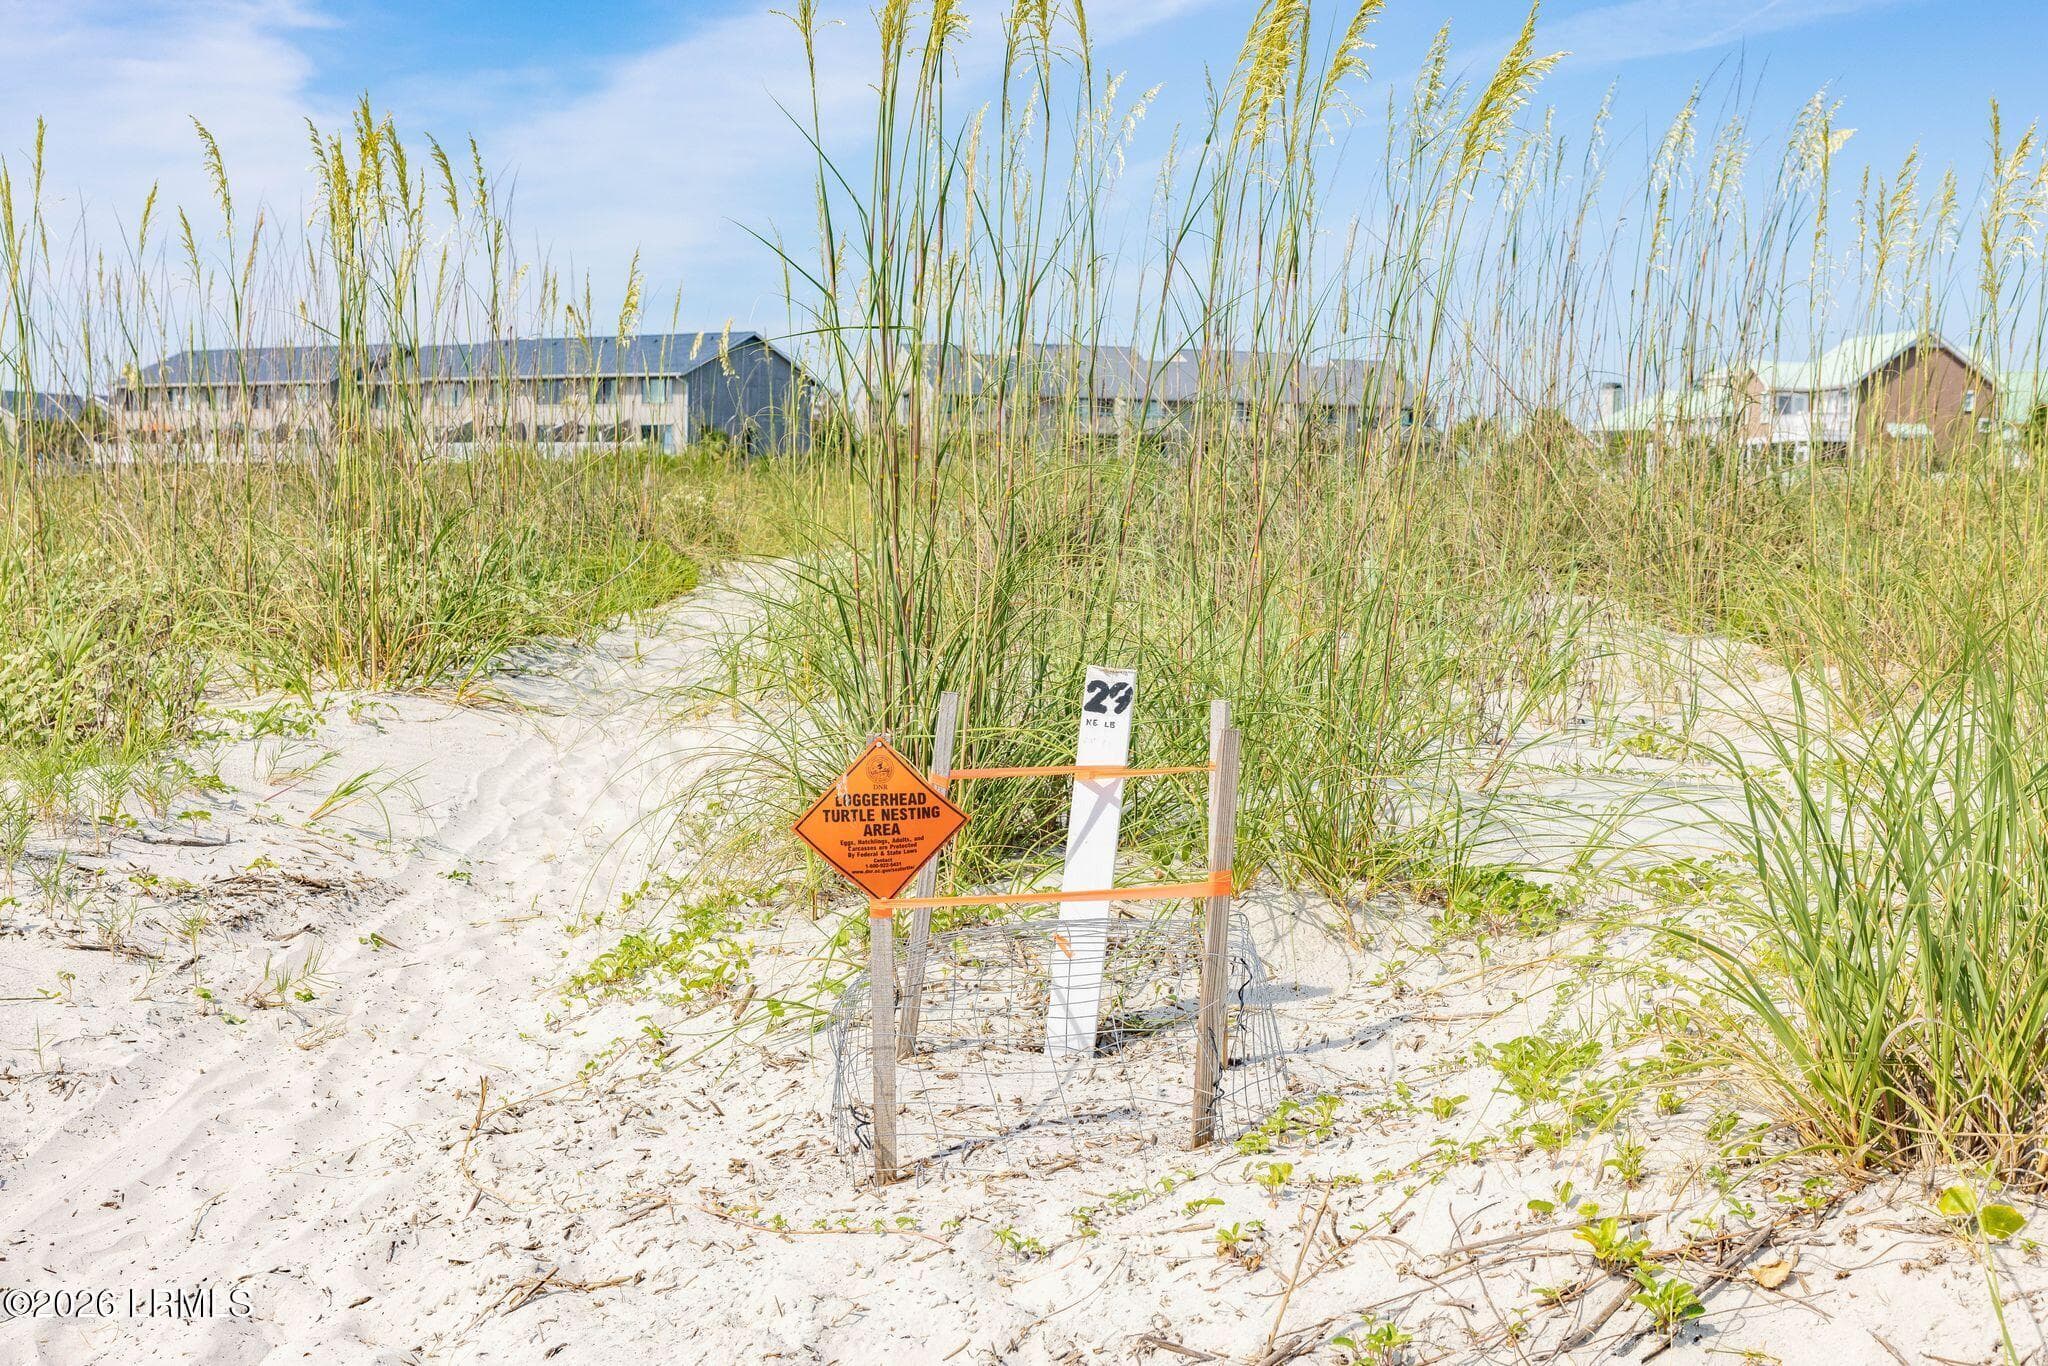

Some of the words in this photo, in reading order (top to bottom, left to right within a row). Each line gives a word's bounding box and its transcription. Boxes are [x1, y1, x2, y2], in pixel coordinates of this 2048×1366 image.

[835, 793, 926, 807] LOGGERHEAD
[822, 808, 875, 823] TURTLE
[881, 806, 941, 821] NESTING
[863, 823, 900, 837] AREA
[857, 838, 890, 846] Hatchlings,
[892, 836, 912, 844] Adults,
